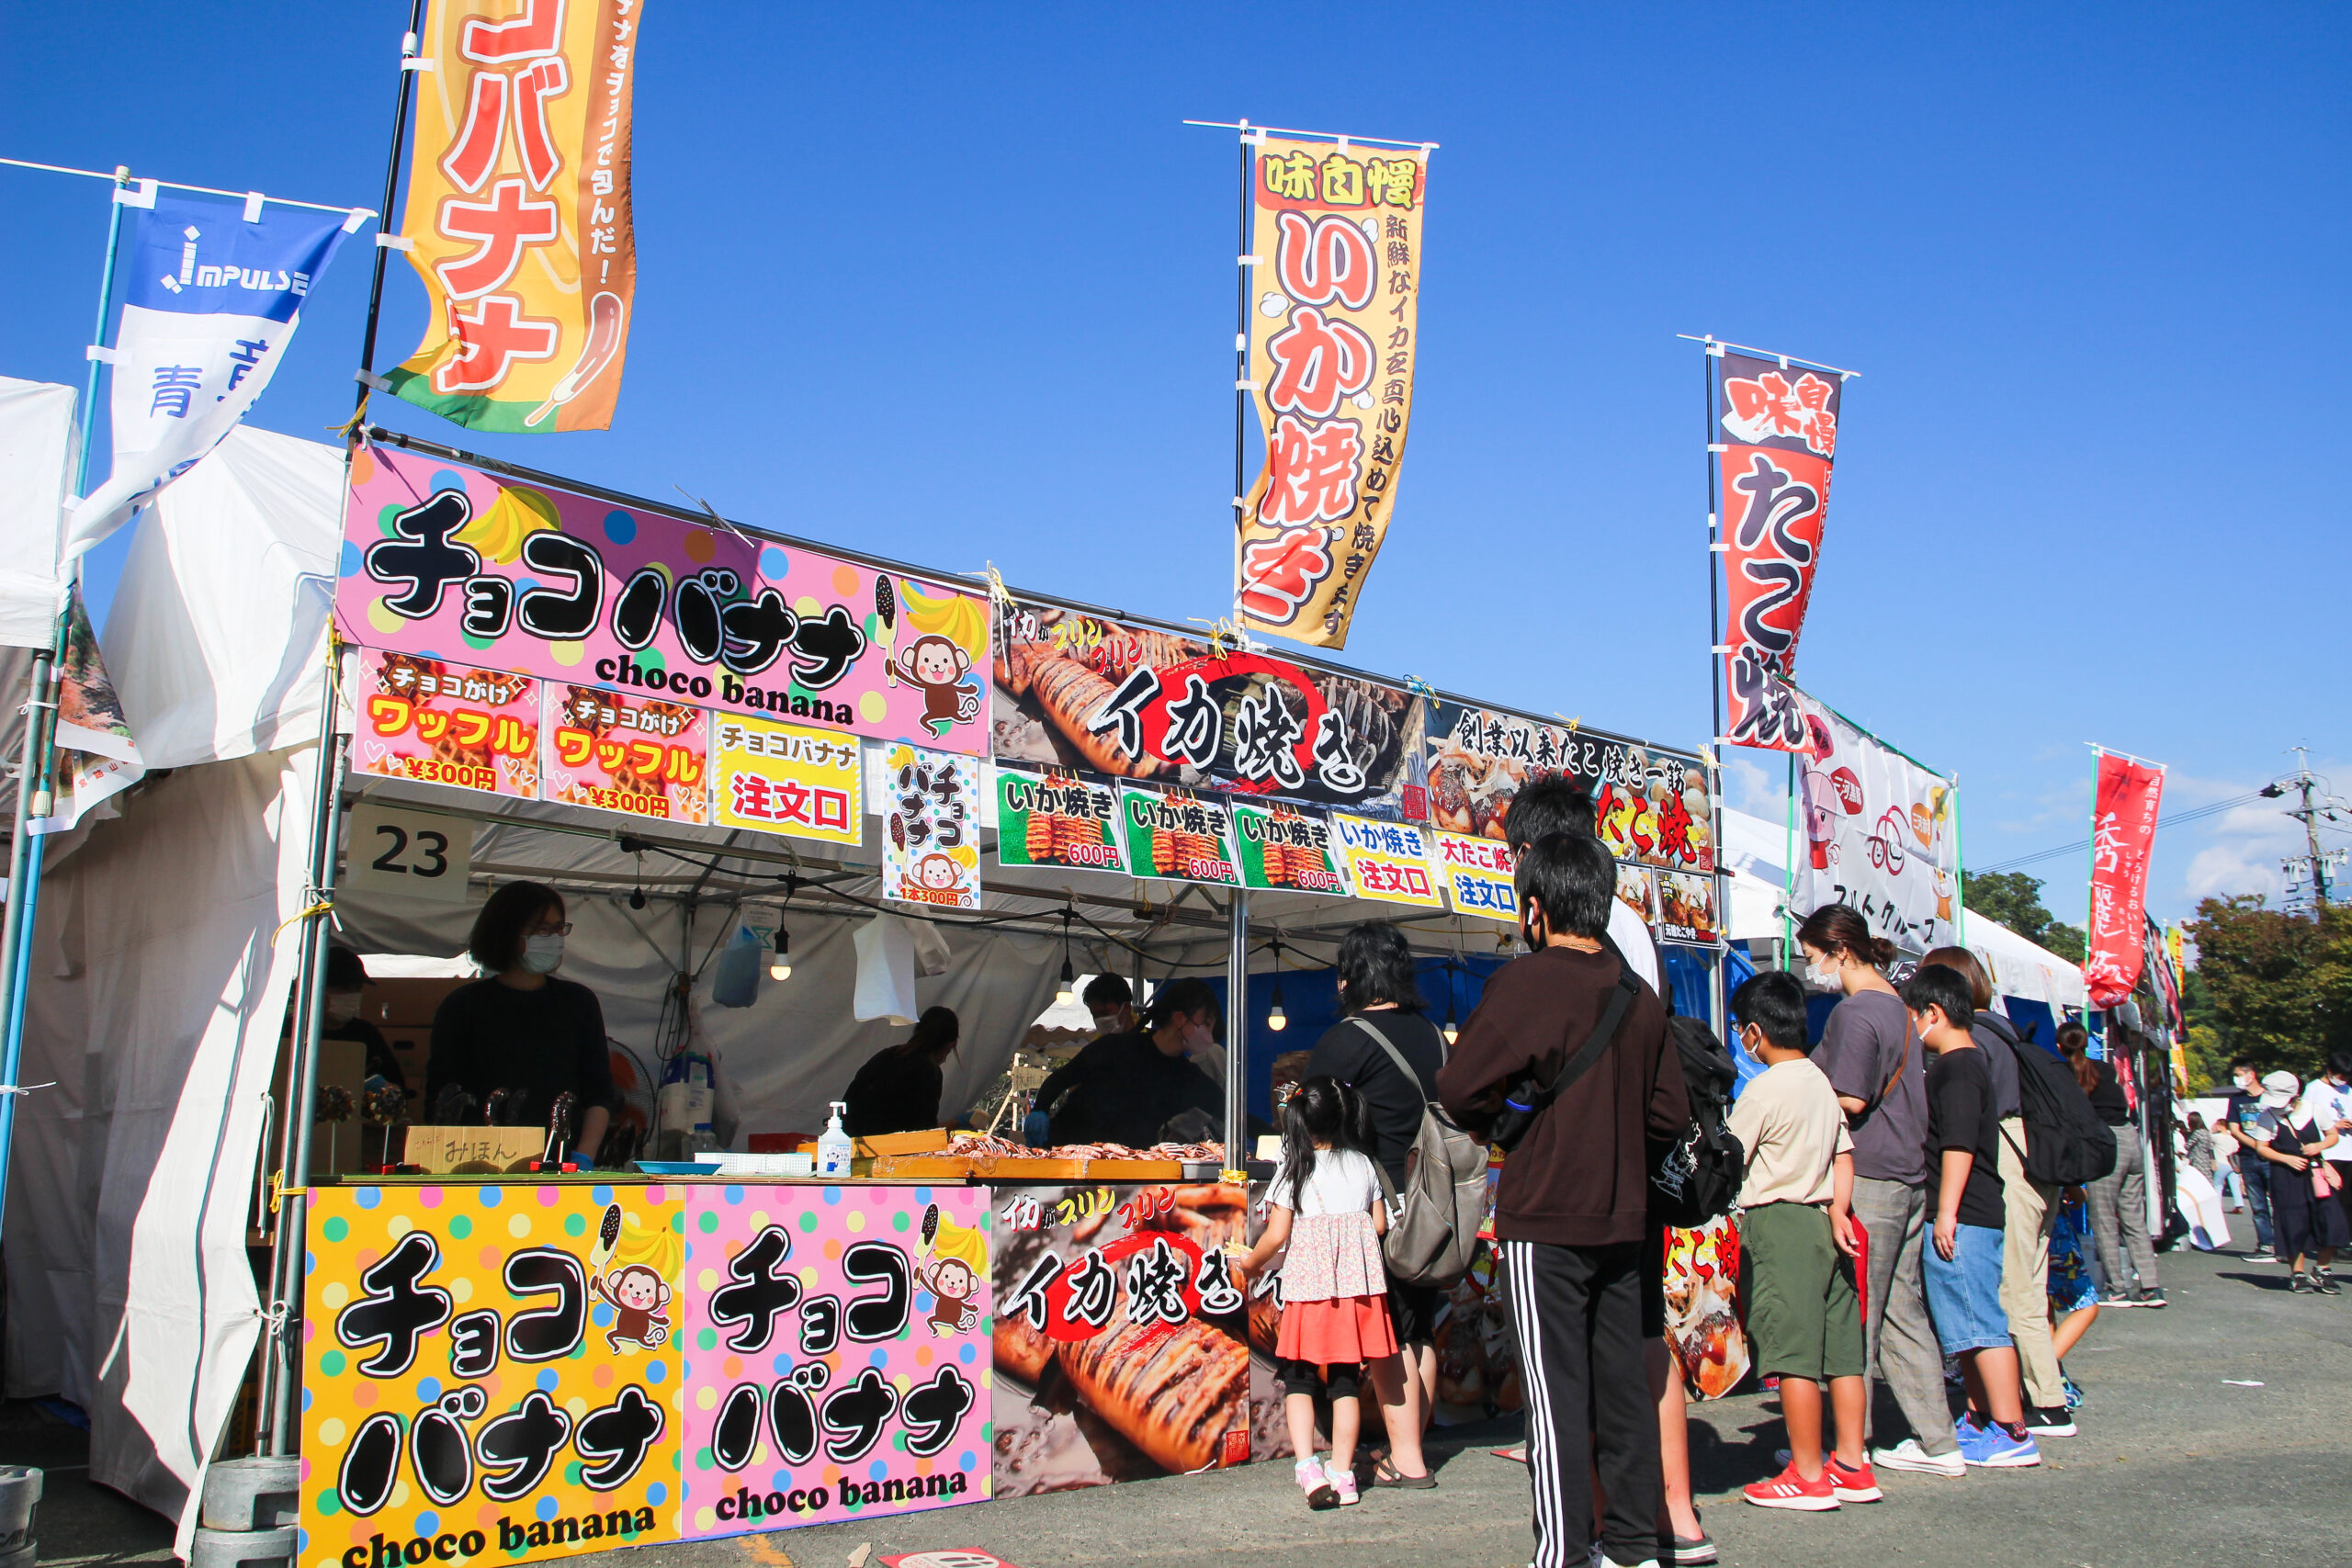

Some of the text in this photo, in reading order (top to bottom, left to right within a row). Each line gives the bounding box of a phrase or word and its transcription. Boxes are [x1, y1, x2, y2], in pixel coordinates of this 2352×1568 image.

[1264, 150, 1417, 210] 味自慢
[1242, 209, 1377, 626] いか焼き
[1324, 214, 1411, 636] 新鮮なイカを真心込めて焼きます
[1724, 371, 1836, 457] 味自慢
[365, 489, 867, 690] チョコバナナ
[392, 666, 511, 707] チョコがけ
[576, 697, 680, 736] チョコがけ
[594, 653, 855, 726] choco banana
[367, 694, 534, 758] ワッフル
[720, 724, 857, 769] チョコバナナ
[1086, 664, 1366, 794] イカ焼き
[1455, 708, 1686, 797] 創業以来たこ焼き一筋
[406, 756, 498, 793] ¥300円
[555, 728, 698, 786] ワッフル
[590, 786, 671, 820] ¥300円
[729, 773, 850, 833] 注文口
[898, 762, 934, 848] バナナ
[930, 763, 966, 849] チョコ
[1006, 781, 1114, 820] いか焼き
[1132, 800, 1227, 838] いか焼き
[2140, 775, 2161, 835] 自然育ちの
[371, 825, 449, 877] 23
[1068, 843, 1121, 867] 600円
[1242, 816, 1330, 850] いか焼き
[1339, 821, 1423, 857] いか焼き
[899, 887, 959, 907] 1本300円
[1189, 858, 1236, 882] 600円
[1297, 869, 1342, 892] 600円
[1357, 860, 1431, 897] 注文口
[1455, 875, 1517, 912] 注文口
[2127, 849, 2145, 946] とろけるおいしさ
[446, 1140, 517, 1163] みほん
[337, 1230, 589, 1380] チョコ
[710, 1224, 912, 1355] チョコ
[1001, 1236, 1244, 1331] イカ焼き
[711, 1359, 976, 1472] バナナ
[337, 1384, 665, 1517] バナナ
[715, 1470, 968, 1521] choco banana
[342, 1505, 657, 1568] choco banana
